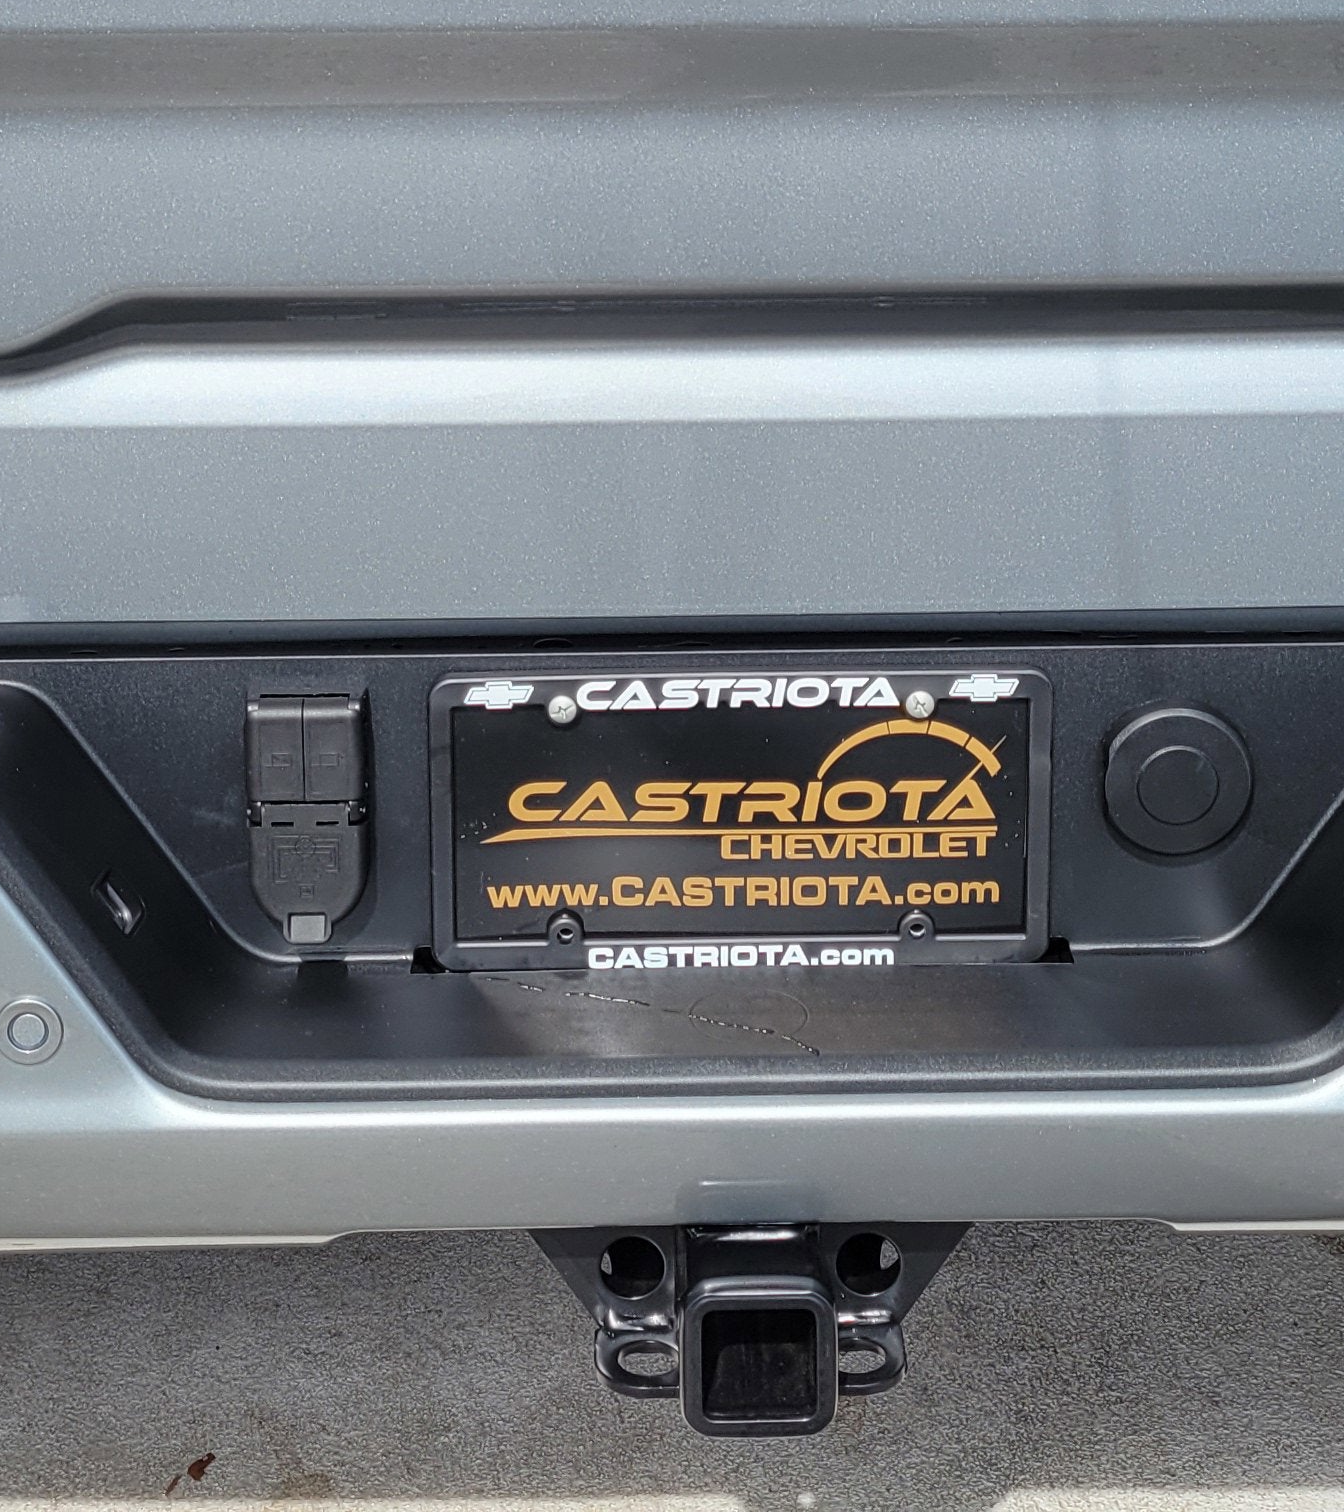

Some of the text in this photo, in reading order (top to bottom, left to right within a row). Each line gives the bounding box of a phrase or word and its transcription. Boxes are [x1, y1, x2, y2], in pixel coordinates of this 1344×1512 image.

[576, 676, 899, 710] CASTRIOTA
[507, 779, 997, 822] CASTRIOTA
[720, 832, 996, 861] CHEVROLET
[487, 875, 1001, 909] www.CASTRIOTA.com
[587, 944, 895, 970] CASTRIOTA.com
